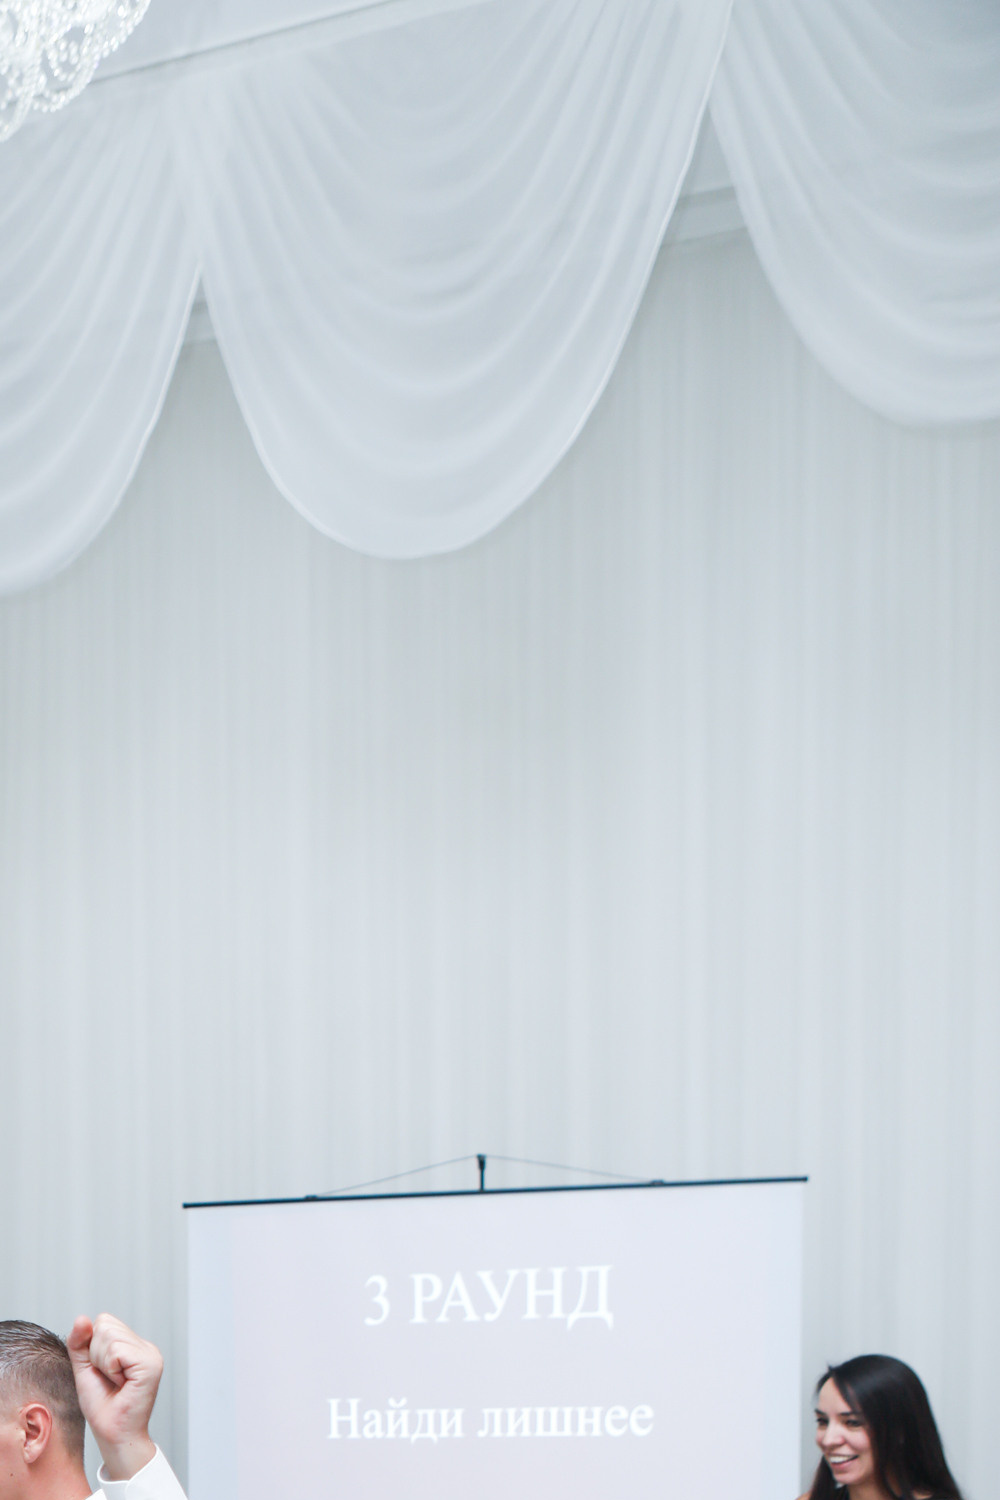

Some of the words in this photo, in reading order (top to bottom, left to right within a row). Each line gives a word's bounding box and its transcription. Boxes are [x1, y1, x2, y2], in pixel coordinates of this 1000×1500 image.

[364, 1274, 391, 1326] 3
[409, 1265, 614, 1331] РАУНД
[327, 1397, 465, 1445] Найди
[477, 1403, 655, 1438] лишнее
